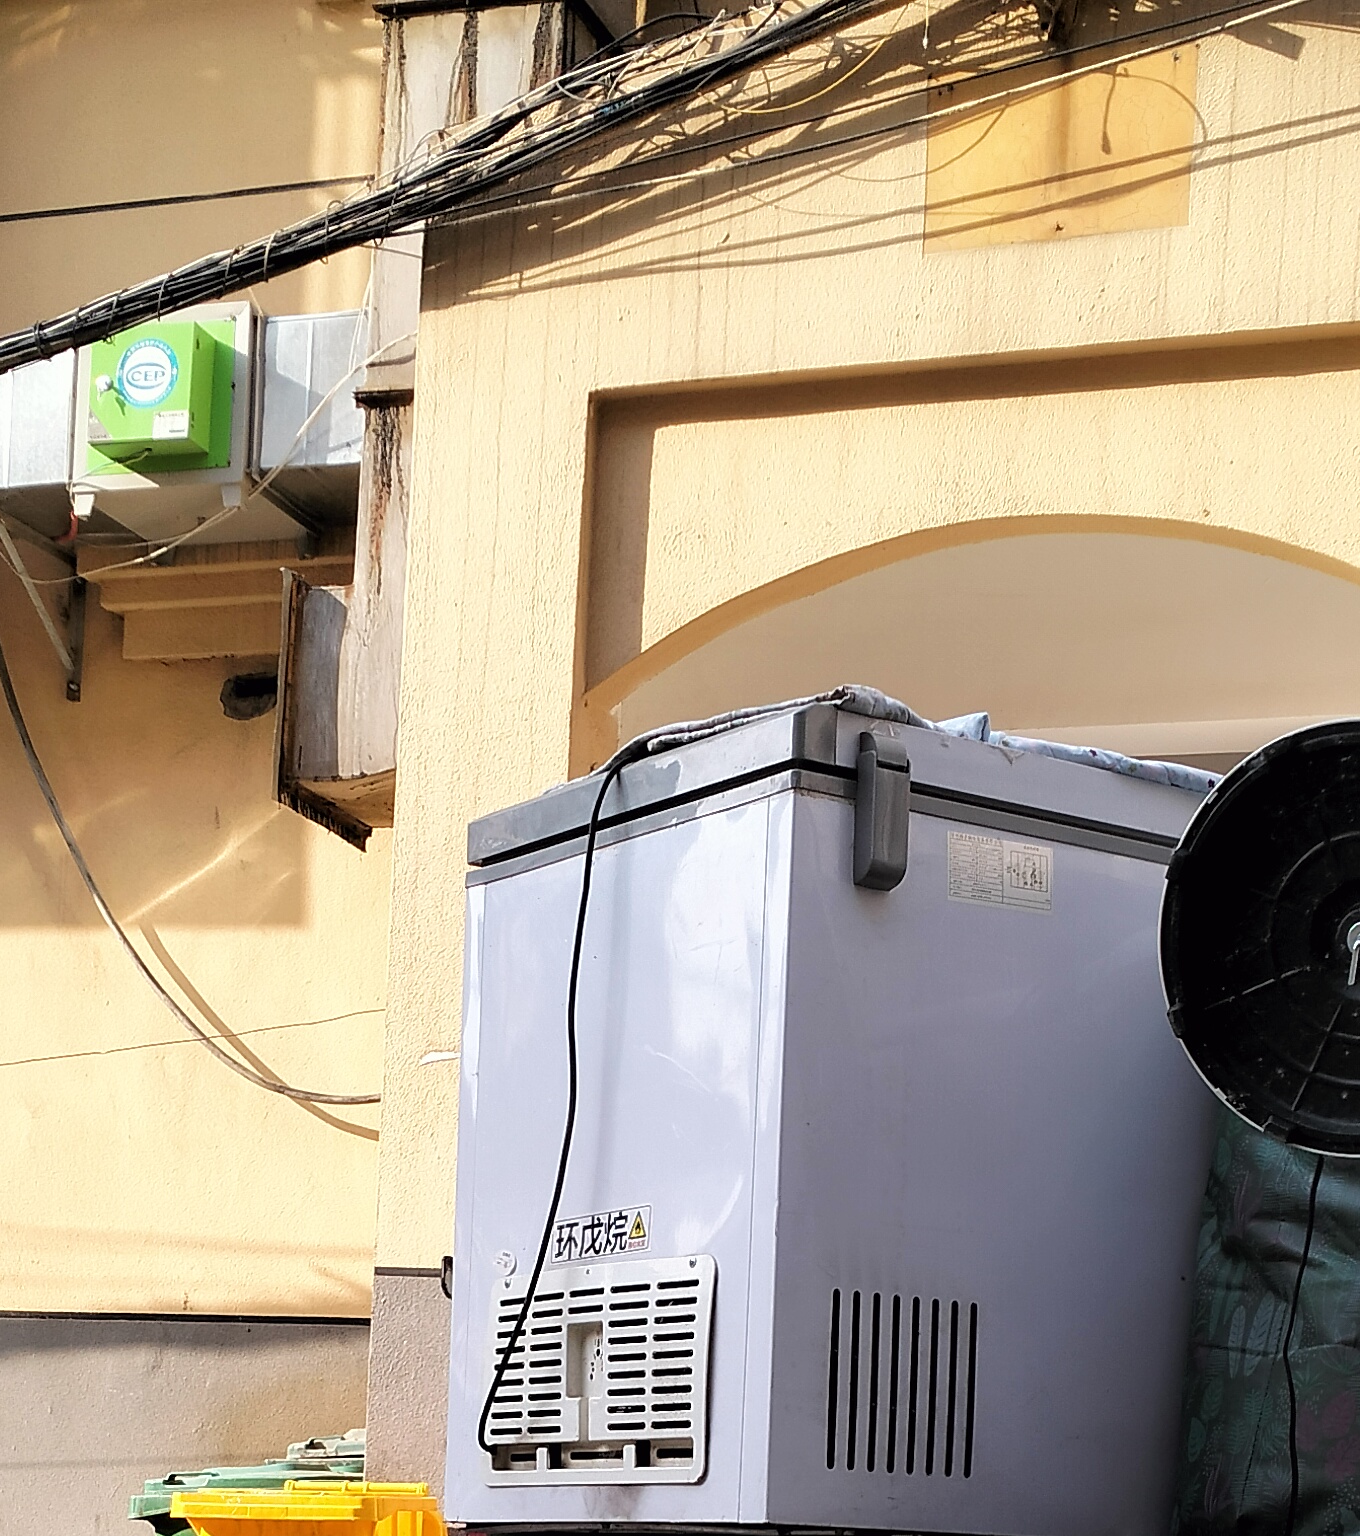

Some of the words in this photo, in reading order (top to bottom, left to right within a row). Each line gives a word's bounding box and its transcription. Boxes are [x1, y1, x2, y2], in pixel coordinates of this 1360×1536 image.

[131, 370, 166, 382] CEP
[554, 1211, 629, 1261] 环戊烷
